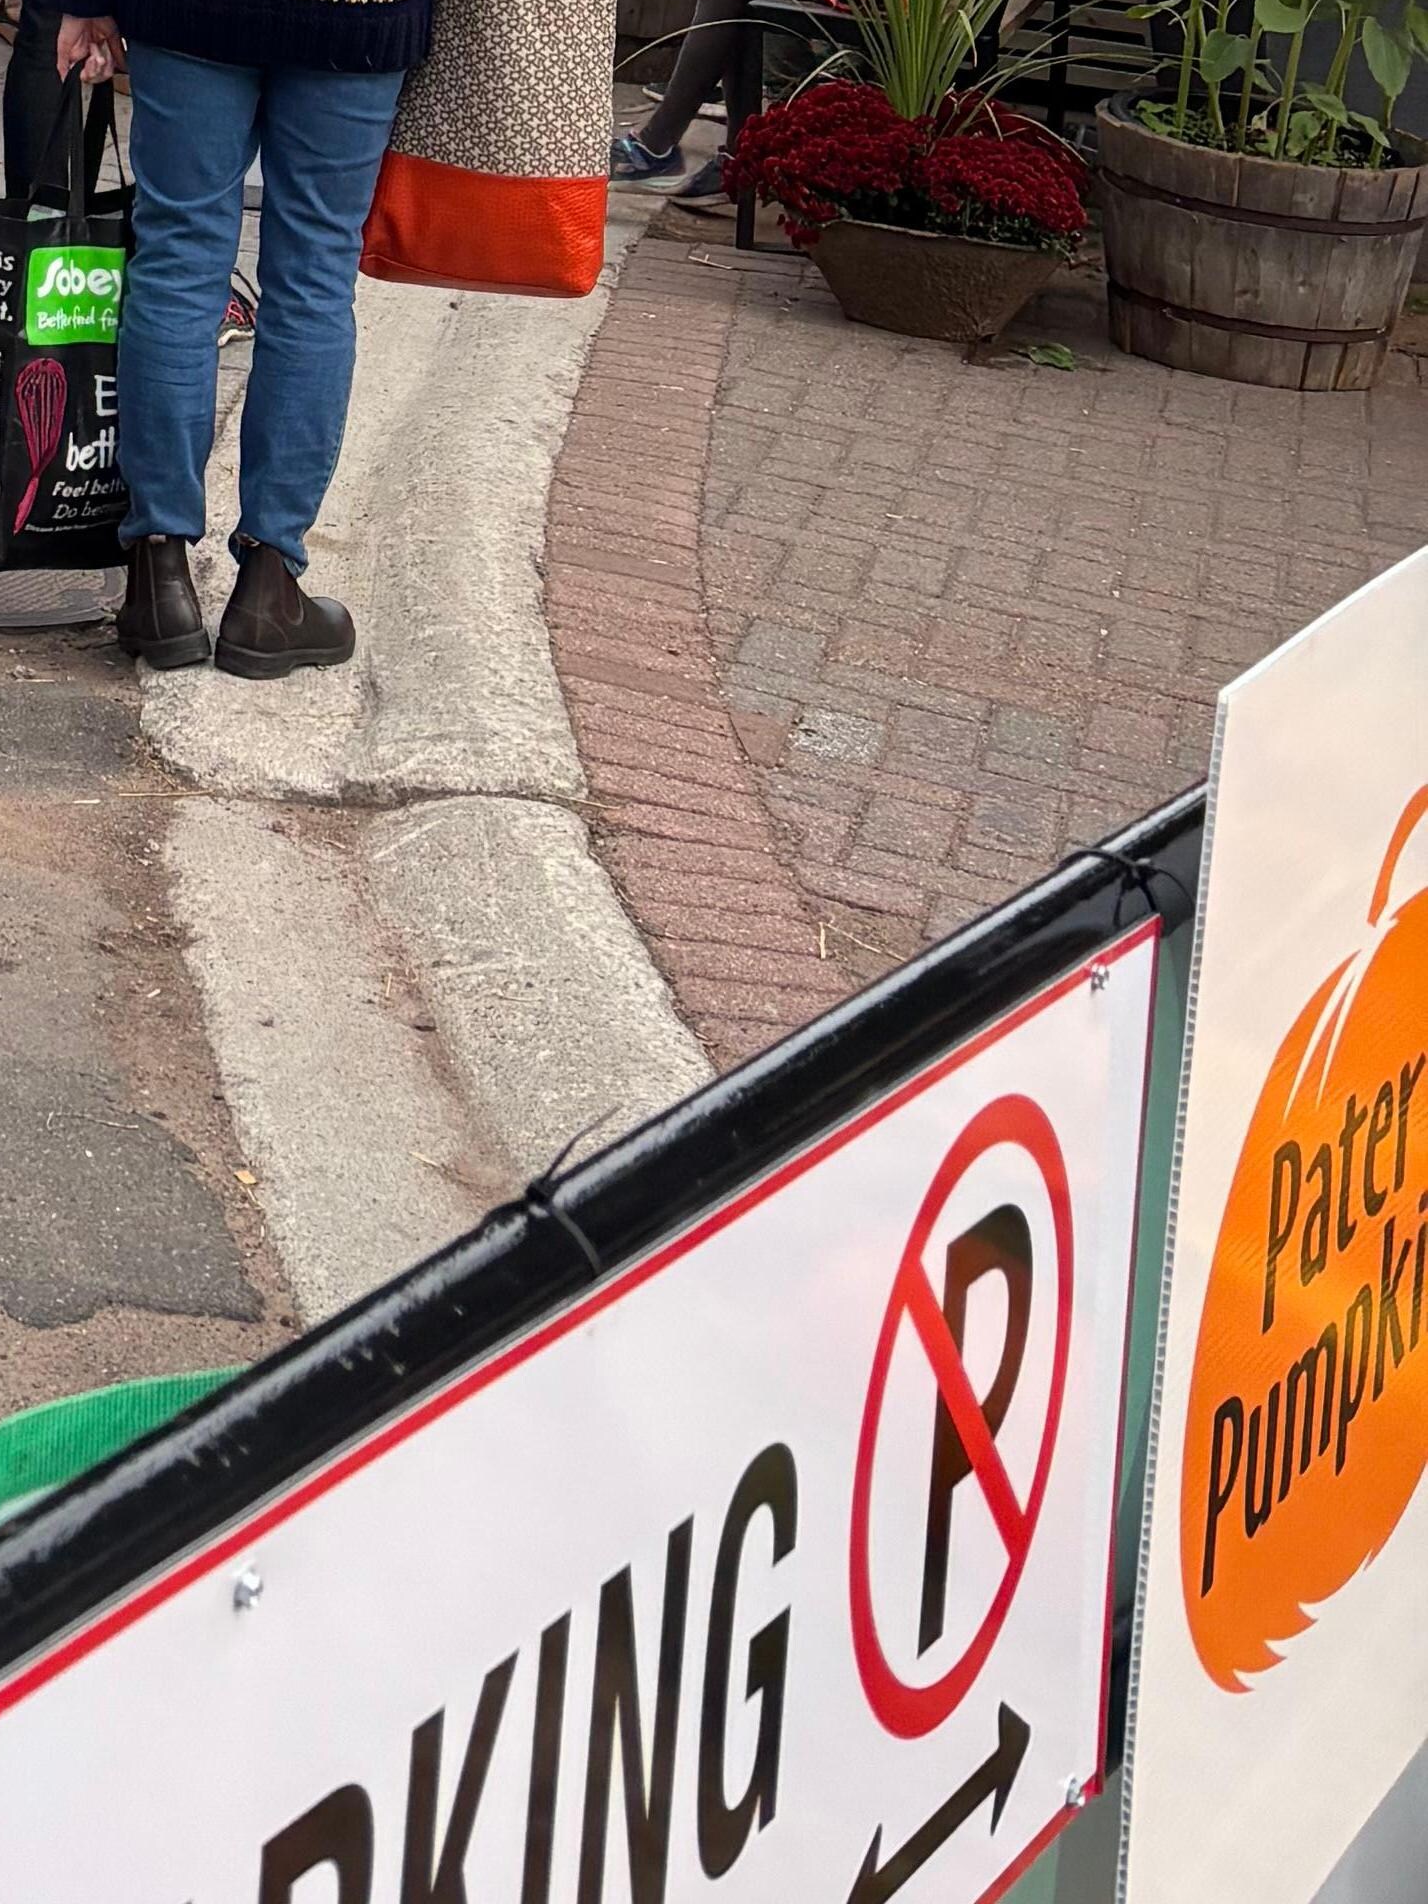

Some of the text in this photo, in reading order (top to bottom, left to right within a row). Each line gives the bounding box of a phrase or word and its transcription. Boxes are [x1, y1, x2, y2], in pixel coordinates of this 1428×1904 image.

[53, 480, 90, 497] Feel
[53, 504, 77, 519] Do
[1259, 1052, 1426, 1335] Pater
